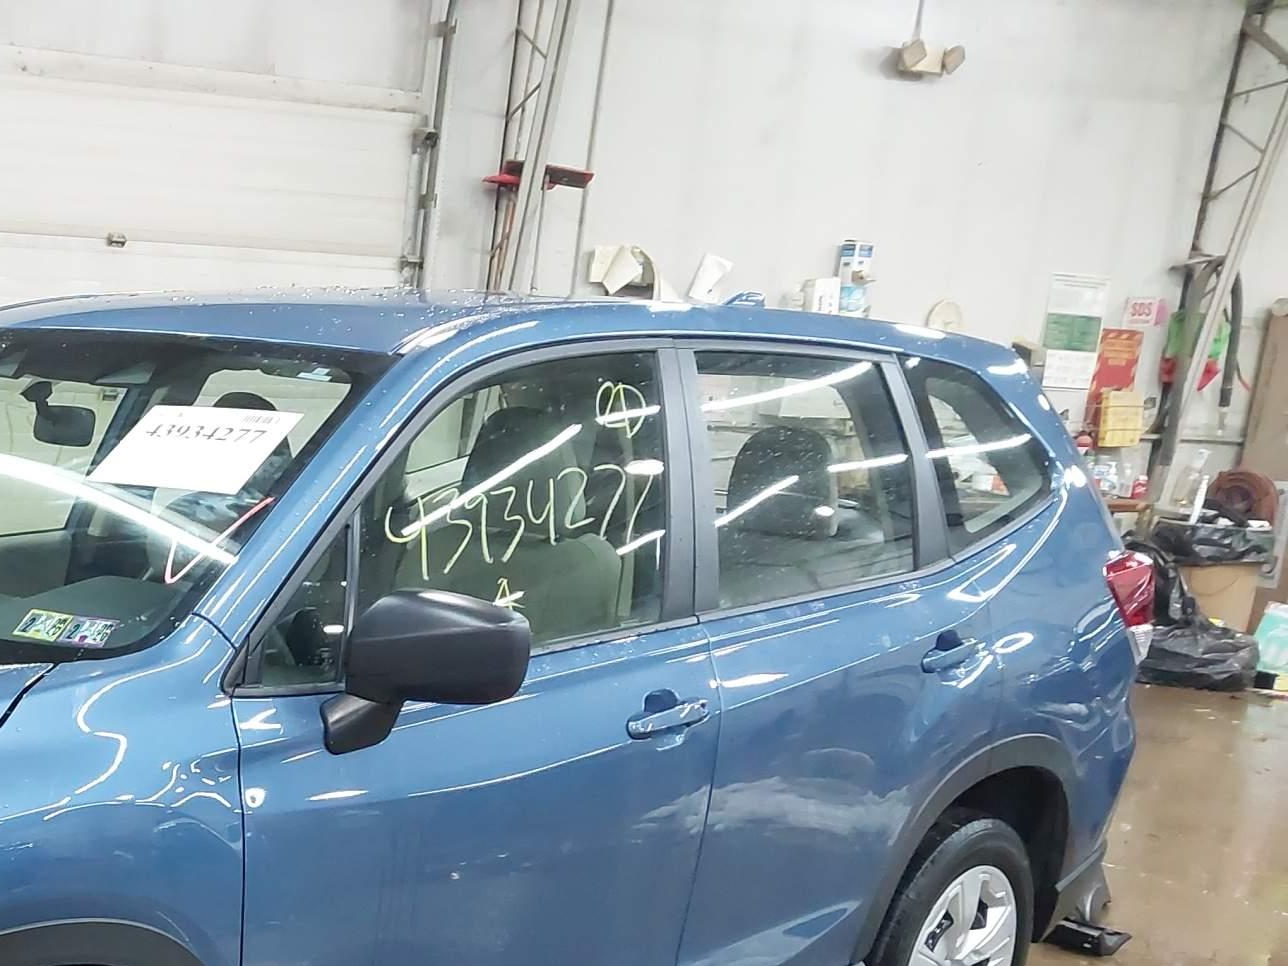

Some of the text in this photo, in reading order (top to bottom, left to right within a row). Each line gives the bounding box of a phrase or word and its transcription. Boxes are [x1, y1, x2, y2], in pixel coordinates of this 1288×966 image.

[1130, 302, 1152, 317] SDS
[145, 423, 268, 444] 43934277
[384, 463, 654, 581] 43934277
[19, 617, 37, 633] 2
[65, 623, 81, 640] 2
